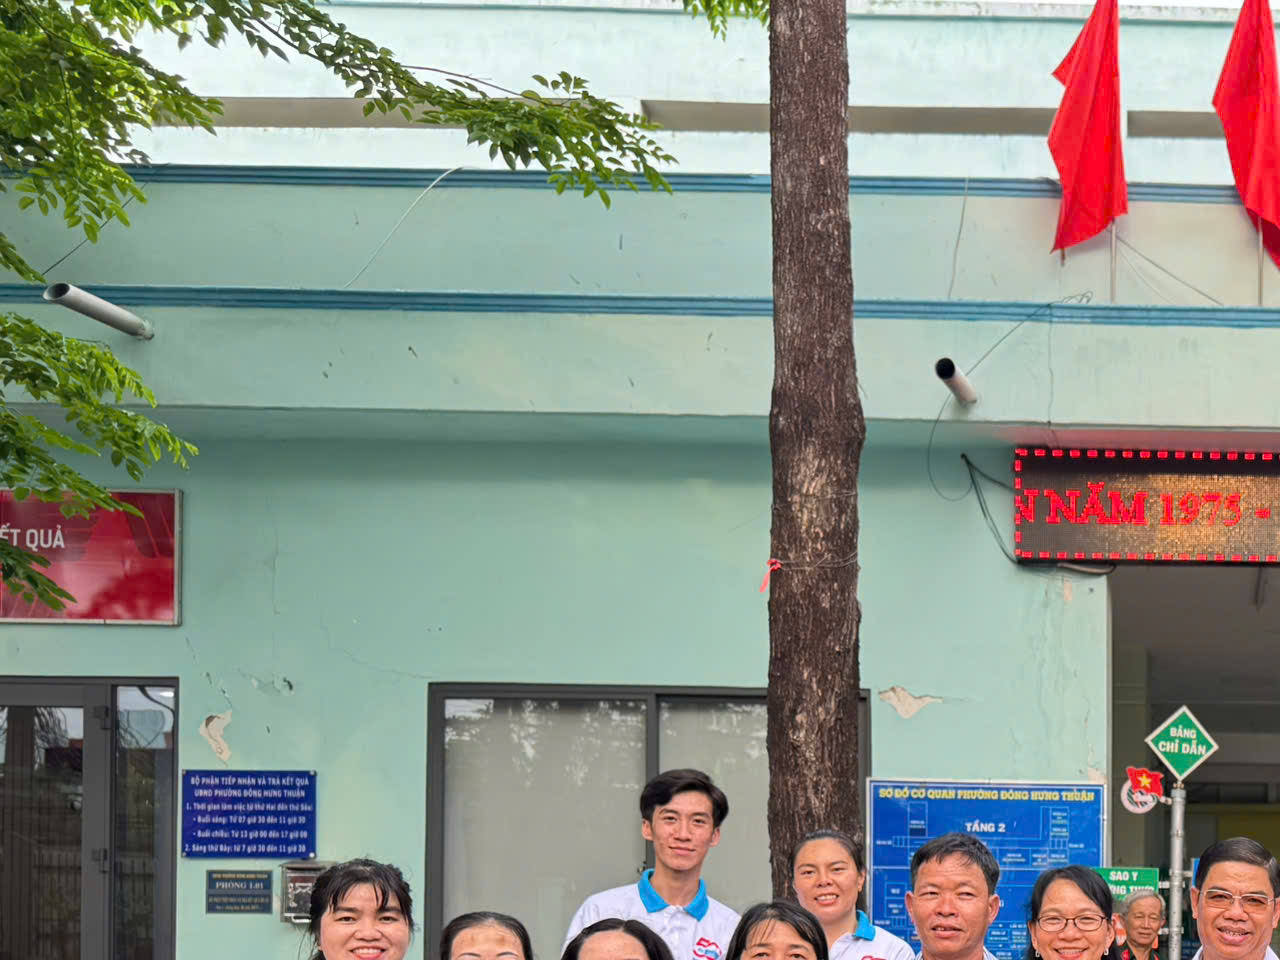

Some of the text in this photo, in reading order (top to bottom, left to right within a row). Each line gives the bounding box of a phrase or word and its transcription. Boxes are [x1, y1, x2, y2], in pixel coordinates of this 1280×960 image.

[1044, 482, 1149, 526] NĂM
[1159, 491, 1242, 527] 1975
[26, 524, 65, 552] QUẢ
[1169, 724, 1197, 739] BẢNG
[1158, 738, 1207, 755] CHỈ DẪN
[927, 789, 956, 799] QUAN
[957, 789, 998, 800] PHƯỜNG
[1000, 789, 1029, 800] ĐÔNG
[1031, 791, 1060, 801] HƯNG
[1061, 787, 1096, 802] THUẬN
[997, 823, 1006, 832] 2
[1109, 871, 1139, 881] SAO Y
[216, 880, 247, 889] PHÒNG
